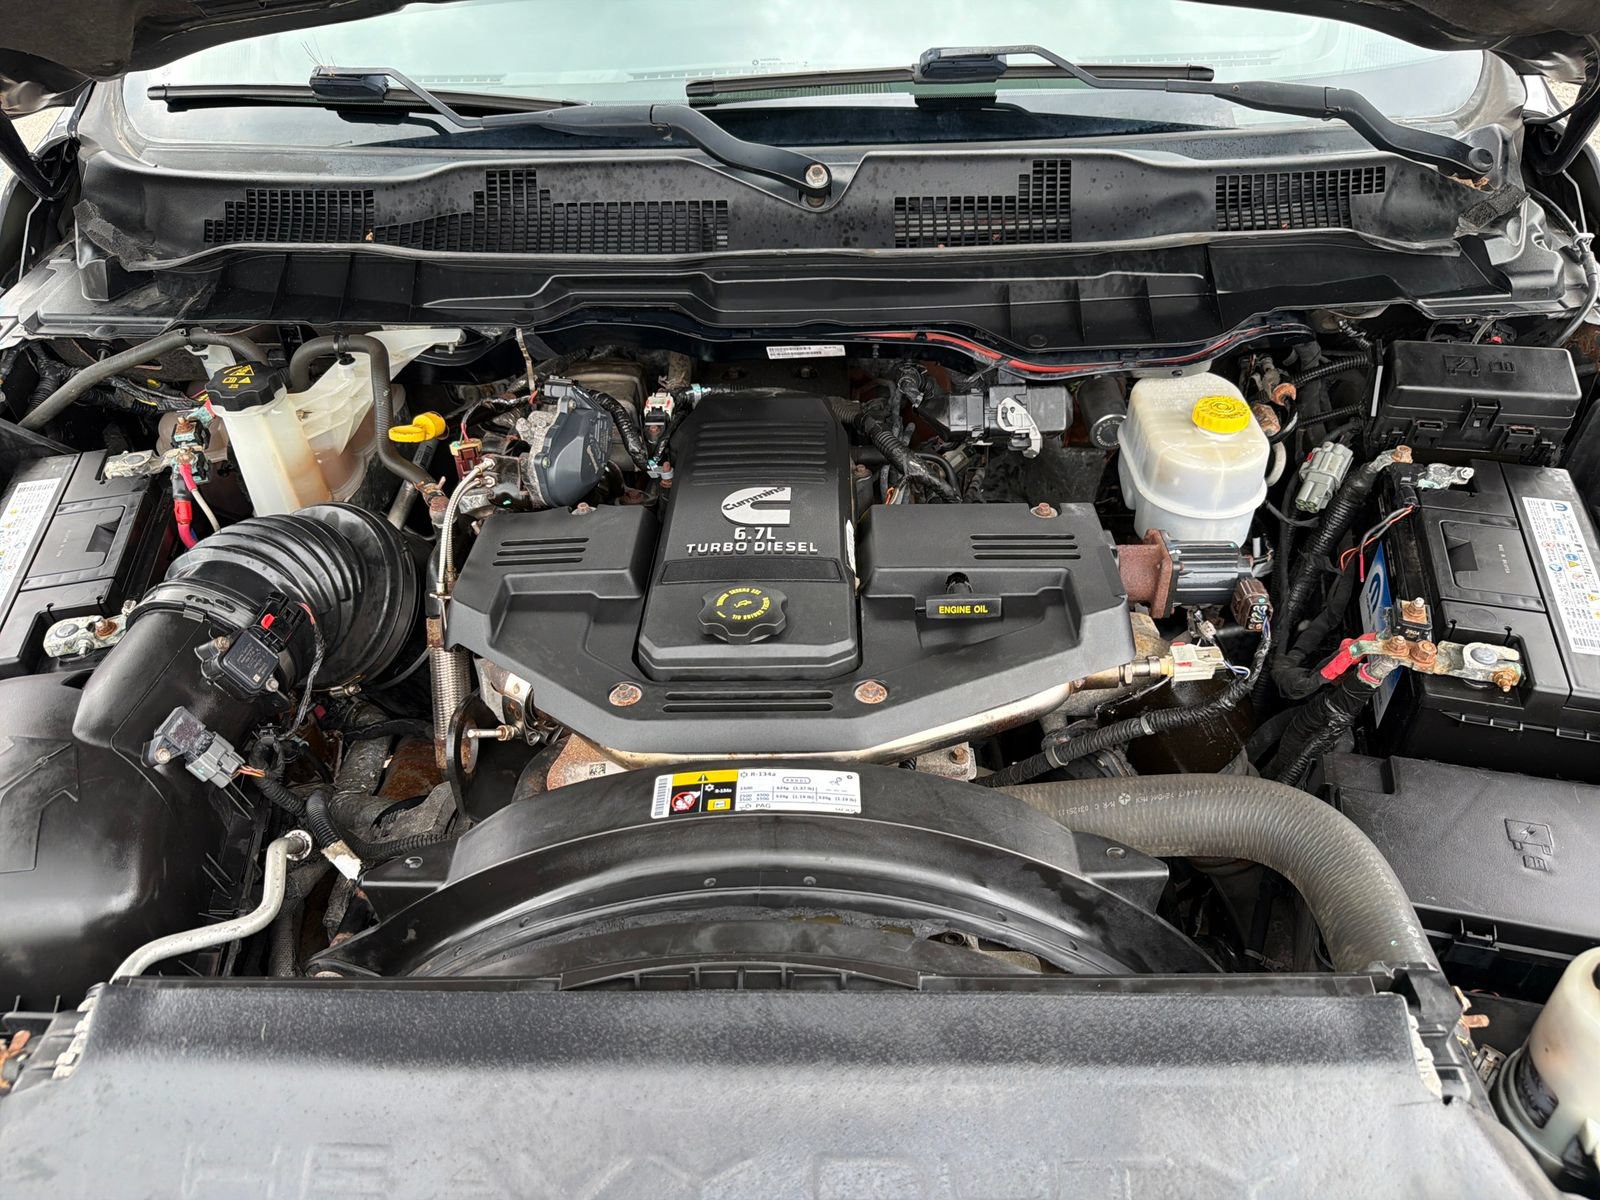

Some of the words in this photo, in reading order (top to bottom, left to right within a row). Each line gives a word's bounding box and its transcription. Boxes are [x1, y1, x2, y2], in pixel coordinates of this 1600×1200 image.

[722, 486, 786, 511] Cummins
[734, 527, 776, 540] 6.7L
[686, 542, 748, 554] TURBO
[754, 541, 818, 552] DIESEL
[938, 605, 971, 614] ENGINE
[973, 604, 989, 613] OIL
